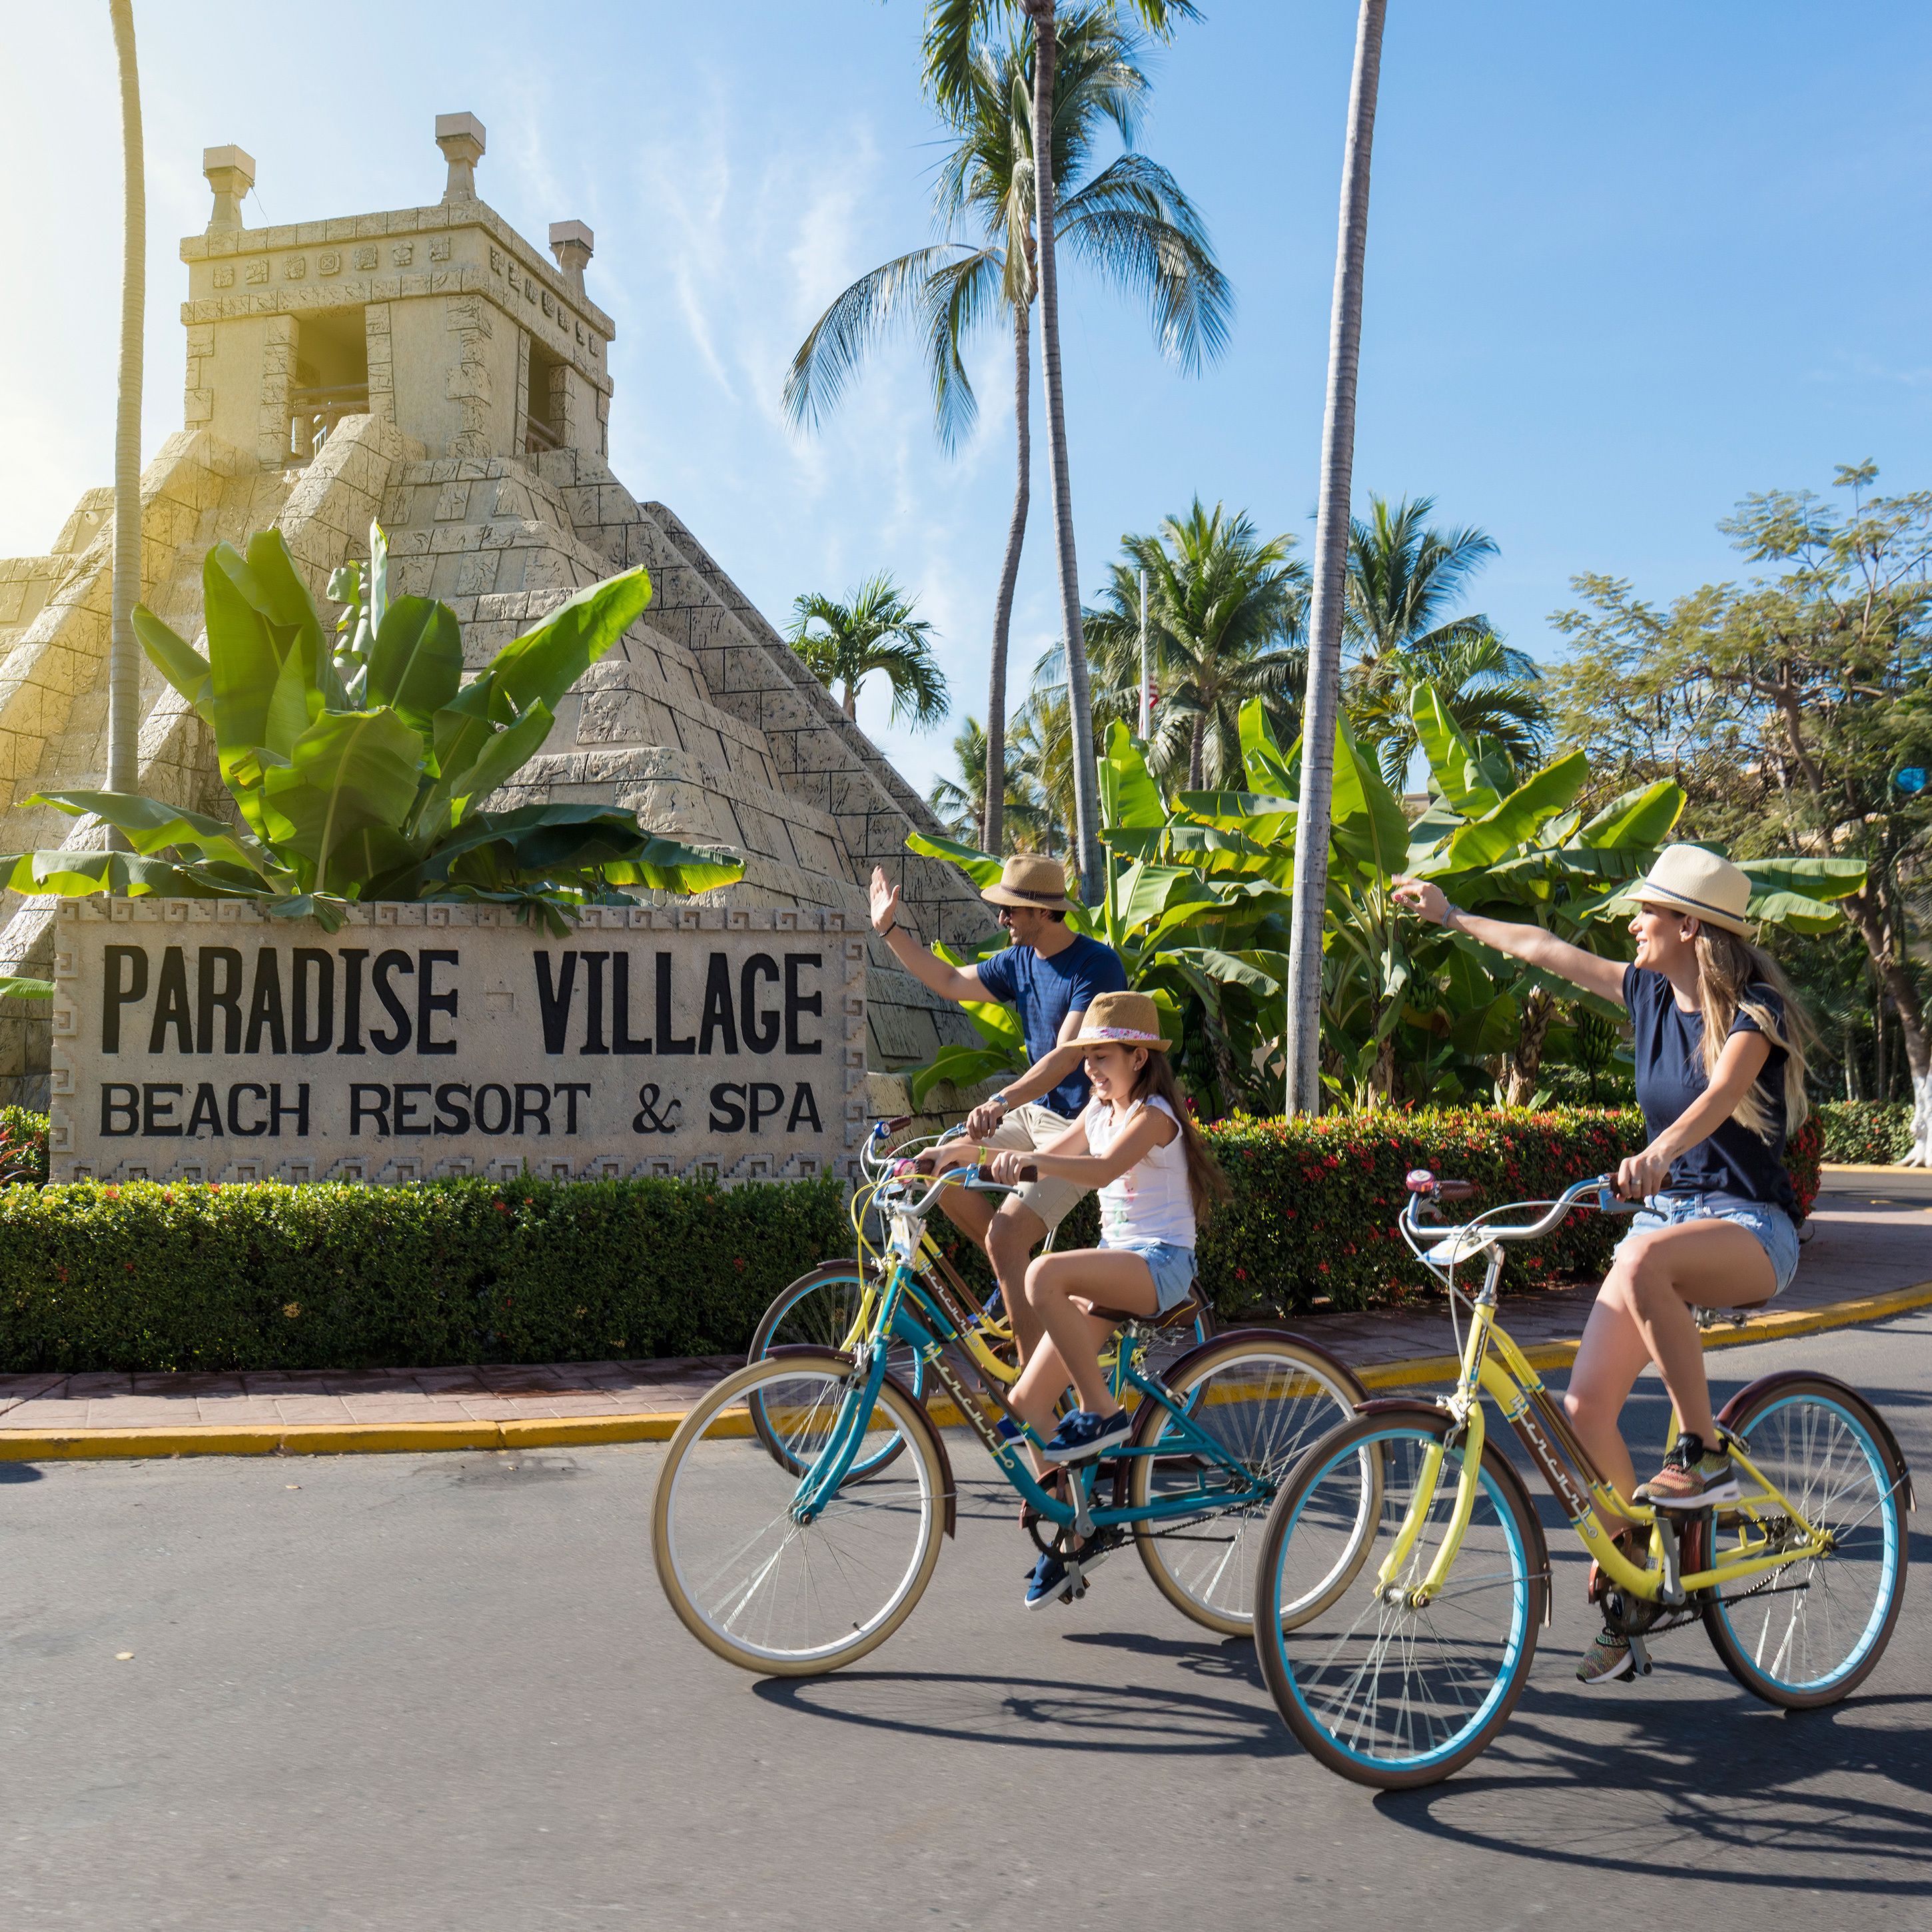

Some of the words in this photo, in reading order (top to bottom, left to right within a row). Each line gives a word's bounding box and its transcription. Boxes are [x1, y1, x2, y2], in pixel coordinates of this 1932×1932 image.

[102, 945, 460, 1056] PARADISE
[533, 950, 823, 1056] VILLAGE
[99, 1083, 310, 1138] BEACH
[348, 1082, 592, 1137] RESORT
[632, 1083, 682, 1134] &
[709, 1081, 824, 1134] SPA
